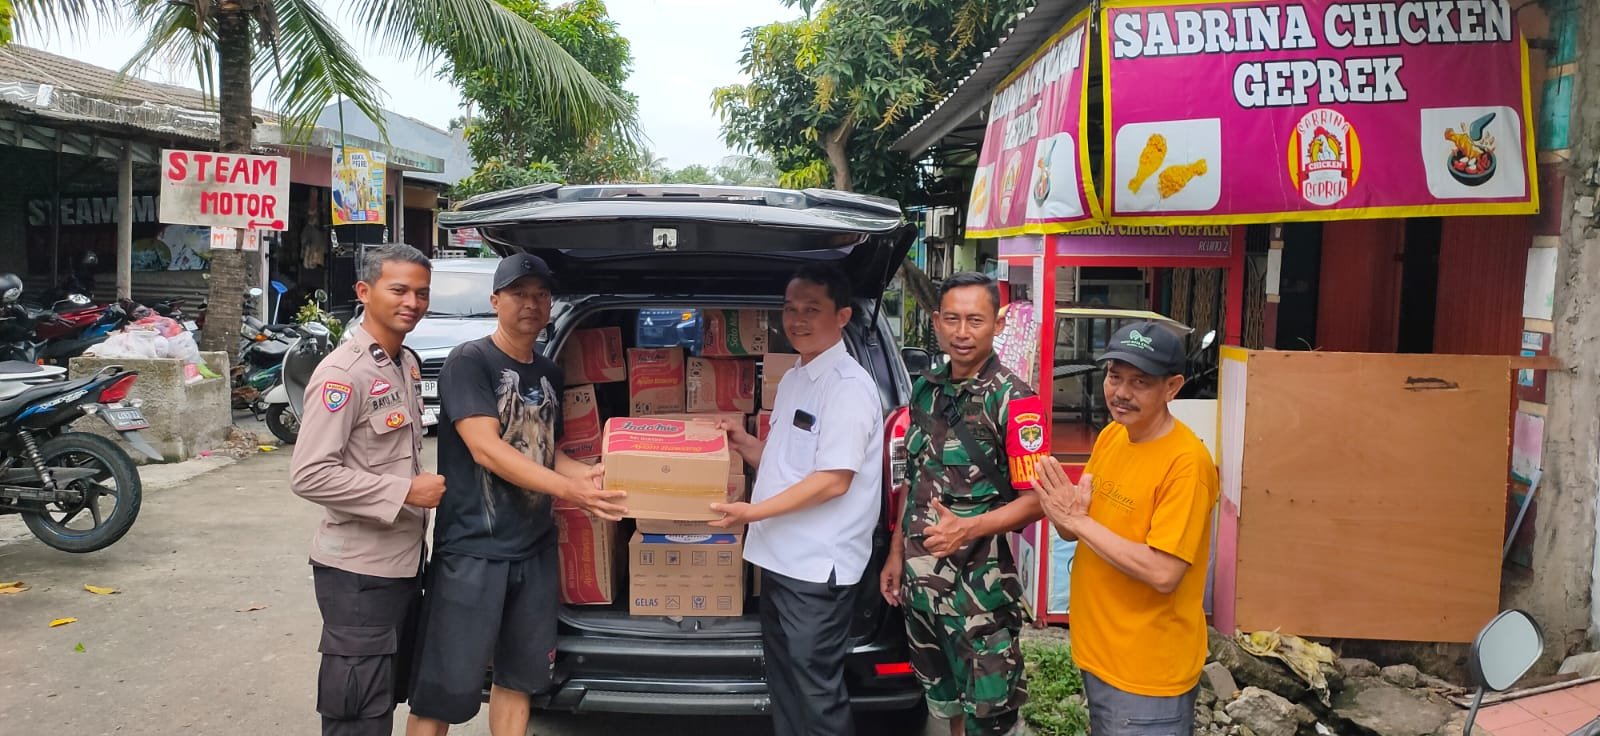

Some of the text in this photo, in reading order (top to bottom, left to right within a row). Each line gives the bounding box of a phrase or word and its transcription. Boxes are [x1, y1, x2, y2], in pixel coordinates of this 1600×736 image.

[1113, 0, 1512, 58] SABRINA CHICKEN
[1232, 56, 1408, 108] GEPREK
[168, 151, 278, 187] STEAM
[200, 191, 277, 219] MOTOR
[1304, 179, 1347, 199] GEPREK
[635, 598, 659, 608] GELAS
